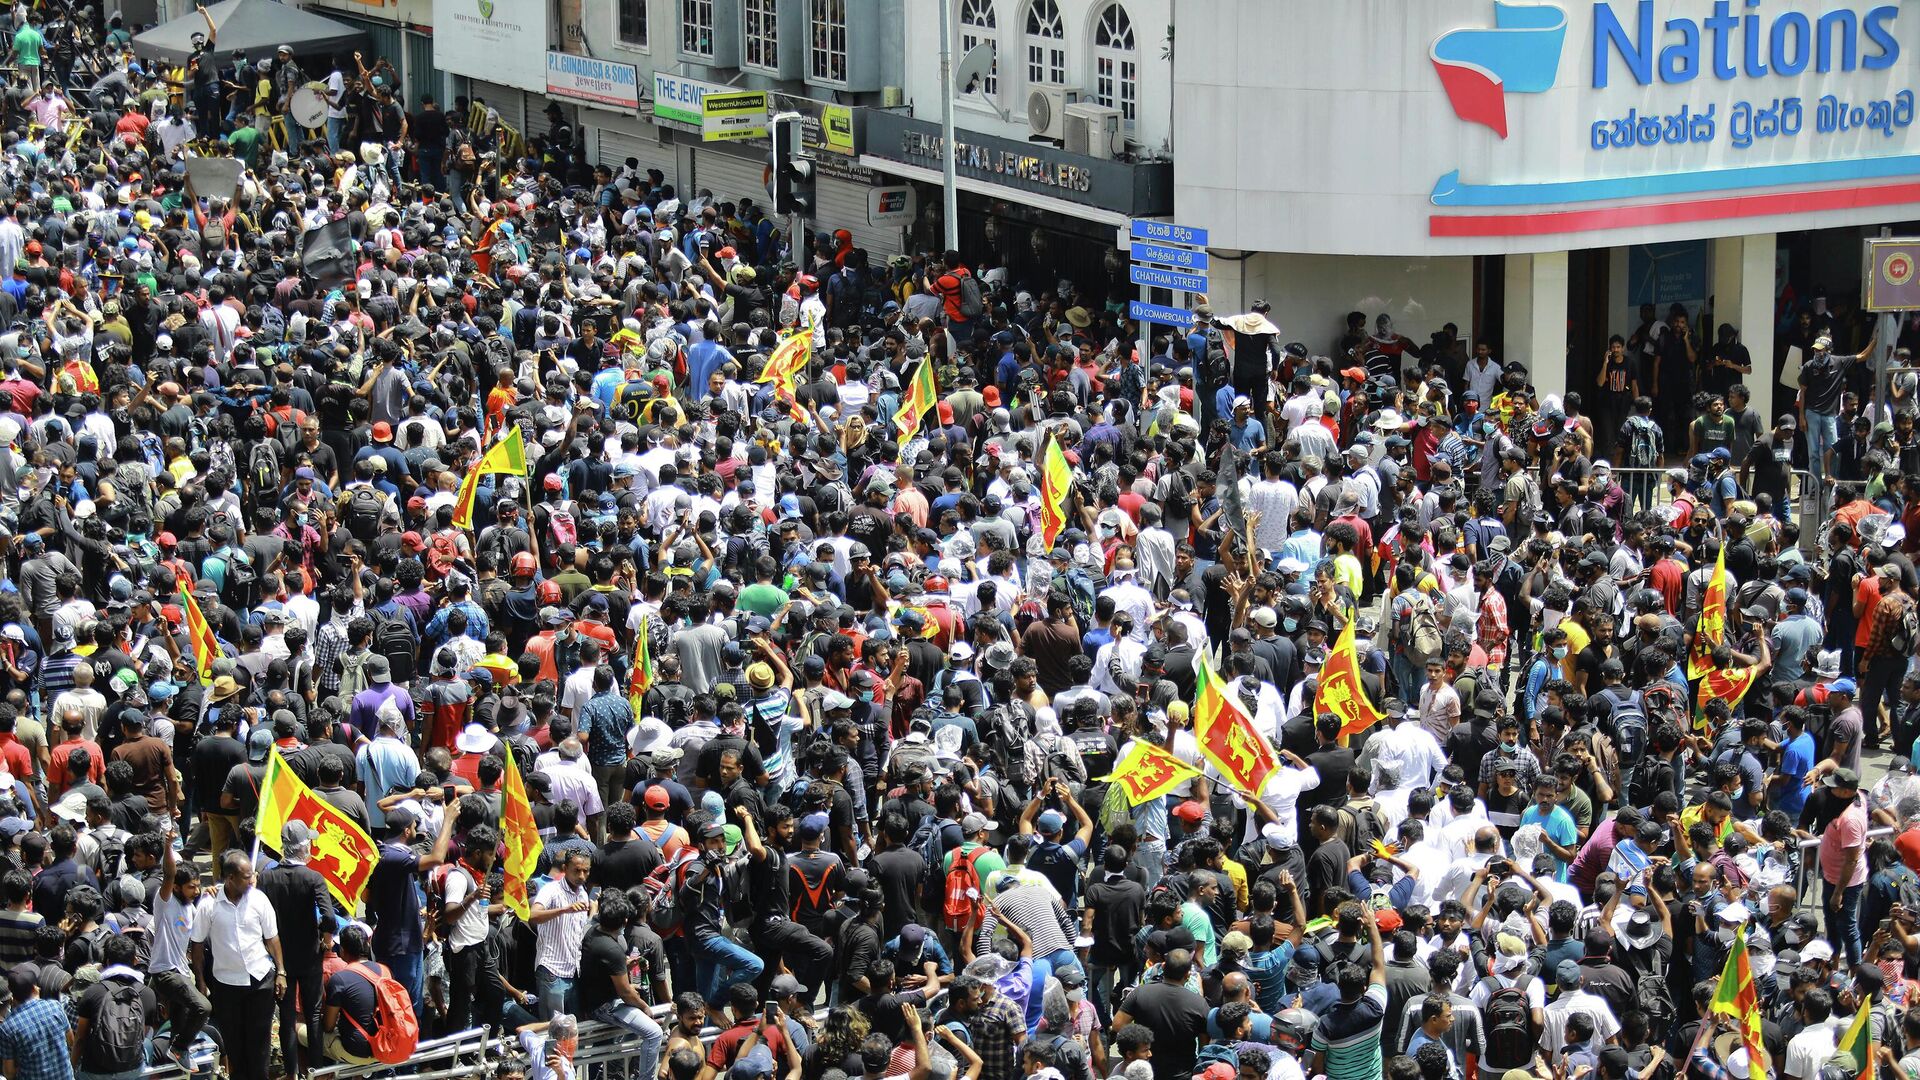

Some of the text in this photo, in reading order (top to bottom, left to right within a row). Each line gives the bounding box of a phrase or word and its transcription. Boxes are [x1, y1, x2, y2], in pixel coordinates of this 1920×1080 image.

[1592, 0, 1901, 88] Nations
[575, 76, 612, 91] Jewellers
[612, 65, 635, 86] SONS
[656, 77, 708, 105] THE JEWE
[995, 150, 1090, 191] JEWELLERS
[1135, 270, 1202, 289] CHATHAM STREET
[1144, 309, 1185, 323] COMMERCIAL
